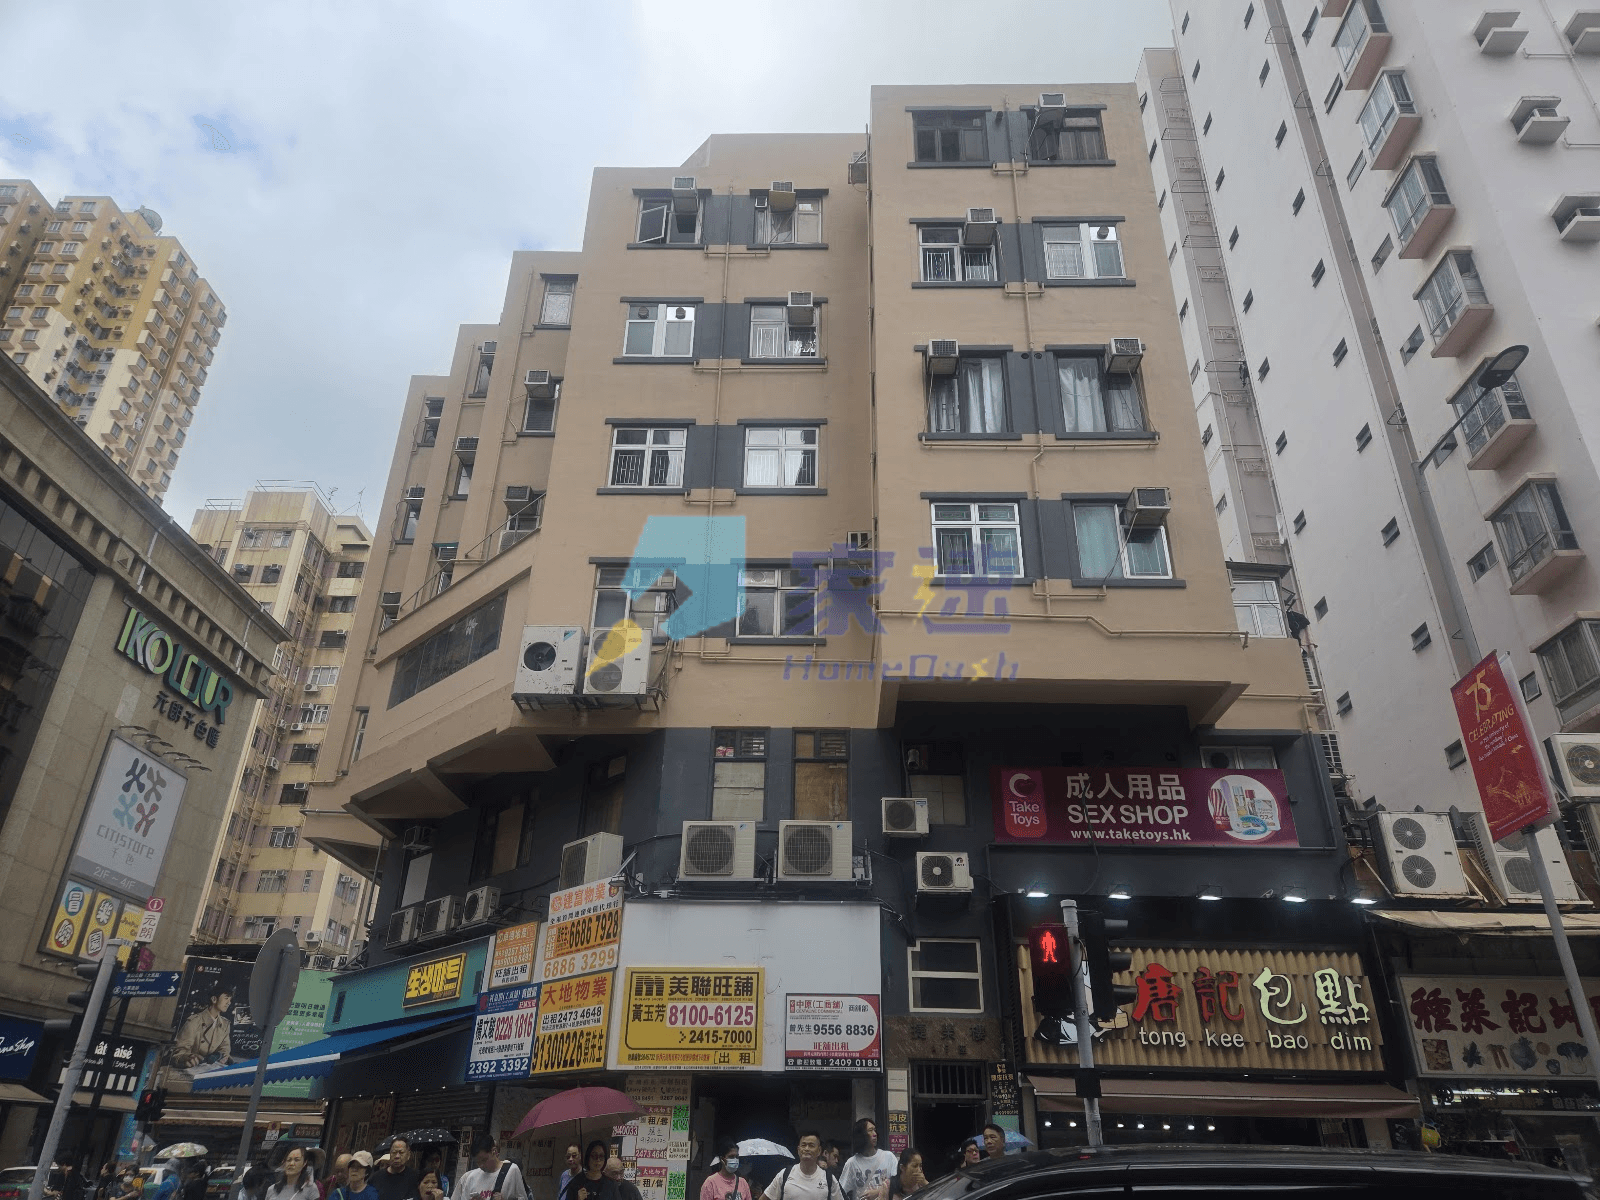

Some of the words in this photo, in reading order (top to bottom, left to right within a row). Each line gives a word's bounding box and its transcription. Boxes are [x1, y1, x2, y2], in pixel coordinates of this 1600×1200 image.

[1465, 668, 1492, 723] 75
[1468, 704, 1515, 743] CELEBRATING
[1066, 773, 1186, 800] 成人用品
[1008, 800, 1040, 813] Take
[1067, 804, 1117, 824] SEX
[1120, 805, 1189, 825] SHOP
[1010, 813, 1040, 827] Toys
[1070, 828, 1192, 842] www.taketoys.hk
[92, 866, 111, 880] 2/F
[119, 878, 137, 891] 4/F
[139, 913, 157, 940] 元朗
[569, 917, 593, 949] 6686
[594, 909, 619, 943] 7928
[544, 956, 576, 979] 6886
[580, 947, 616, 971] 3299
[543, 976, 607, 1006] 大地物業
[668, 976, 753, 997] 美聯旺舖
[1131, 962, 1371, 1026] 唐記包點
[515, 1012, 534, 1039] 1816
[542, 1012, 558, 1025] 出租
[558, 1011, 578, 1024] 2473
[580, 1006, 601, 1019] 4648
[631, 1004, 666, 1022] 黃玉芳
[668, 1005, 754, 1026] 8100-6125
[689, 1030, 753, 1044] 2415-7000
[789, 1024, 812, 1033] 曾先生
[813, 1023, 842, 1036] 9556
[845, 1024, 875, 1036] 8836
[1139, 1026, 1187, 1048] tong
[1205, 1028, 1245, 1047] kee
[1267, 1030, 1309, 1050] bao
[1330, 1032, 1372, 1051] dim
[468, 1060, 497, 1075] 2392
[500, 1058, 529, 1072] 3392
[829, 1059, 852, 1067] 2409
[855, 1059, 879, 1067] 0188
